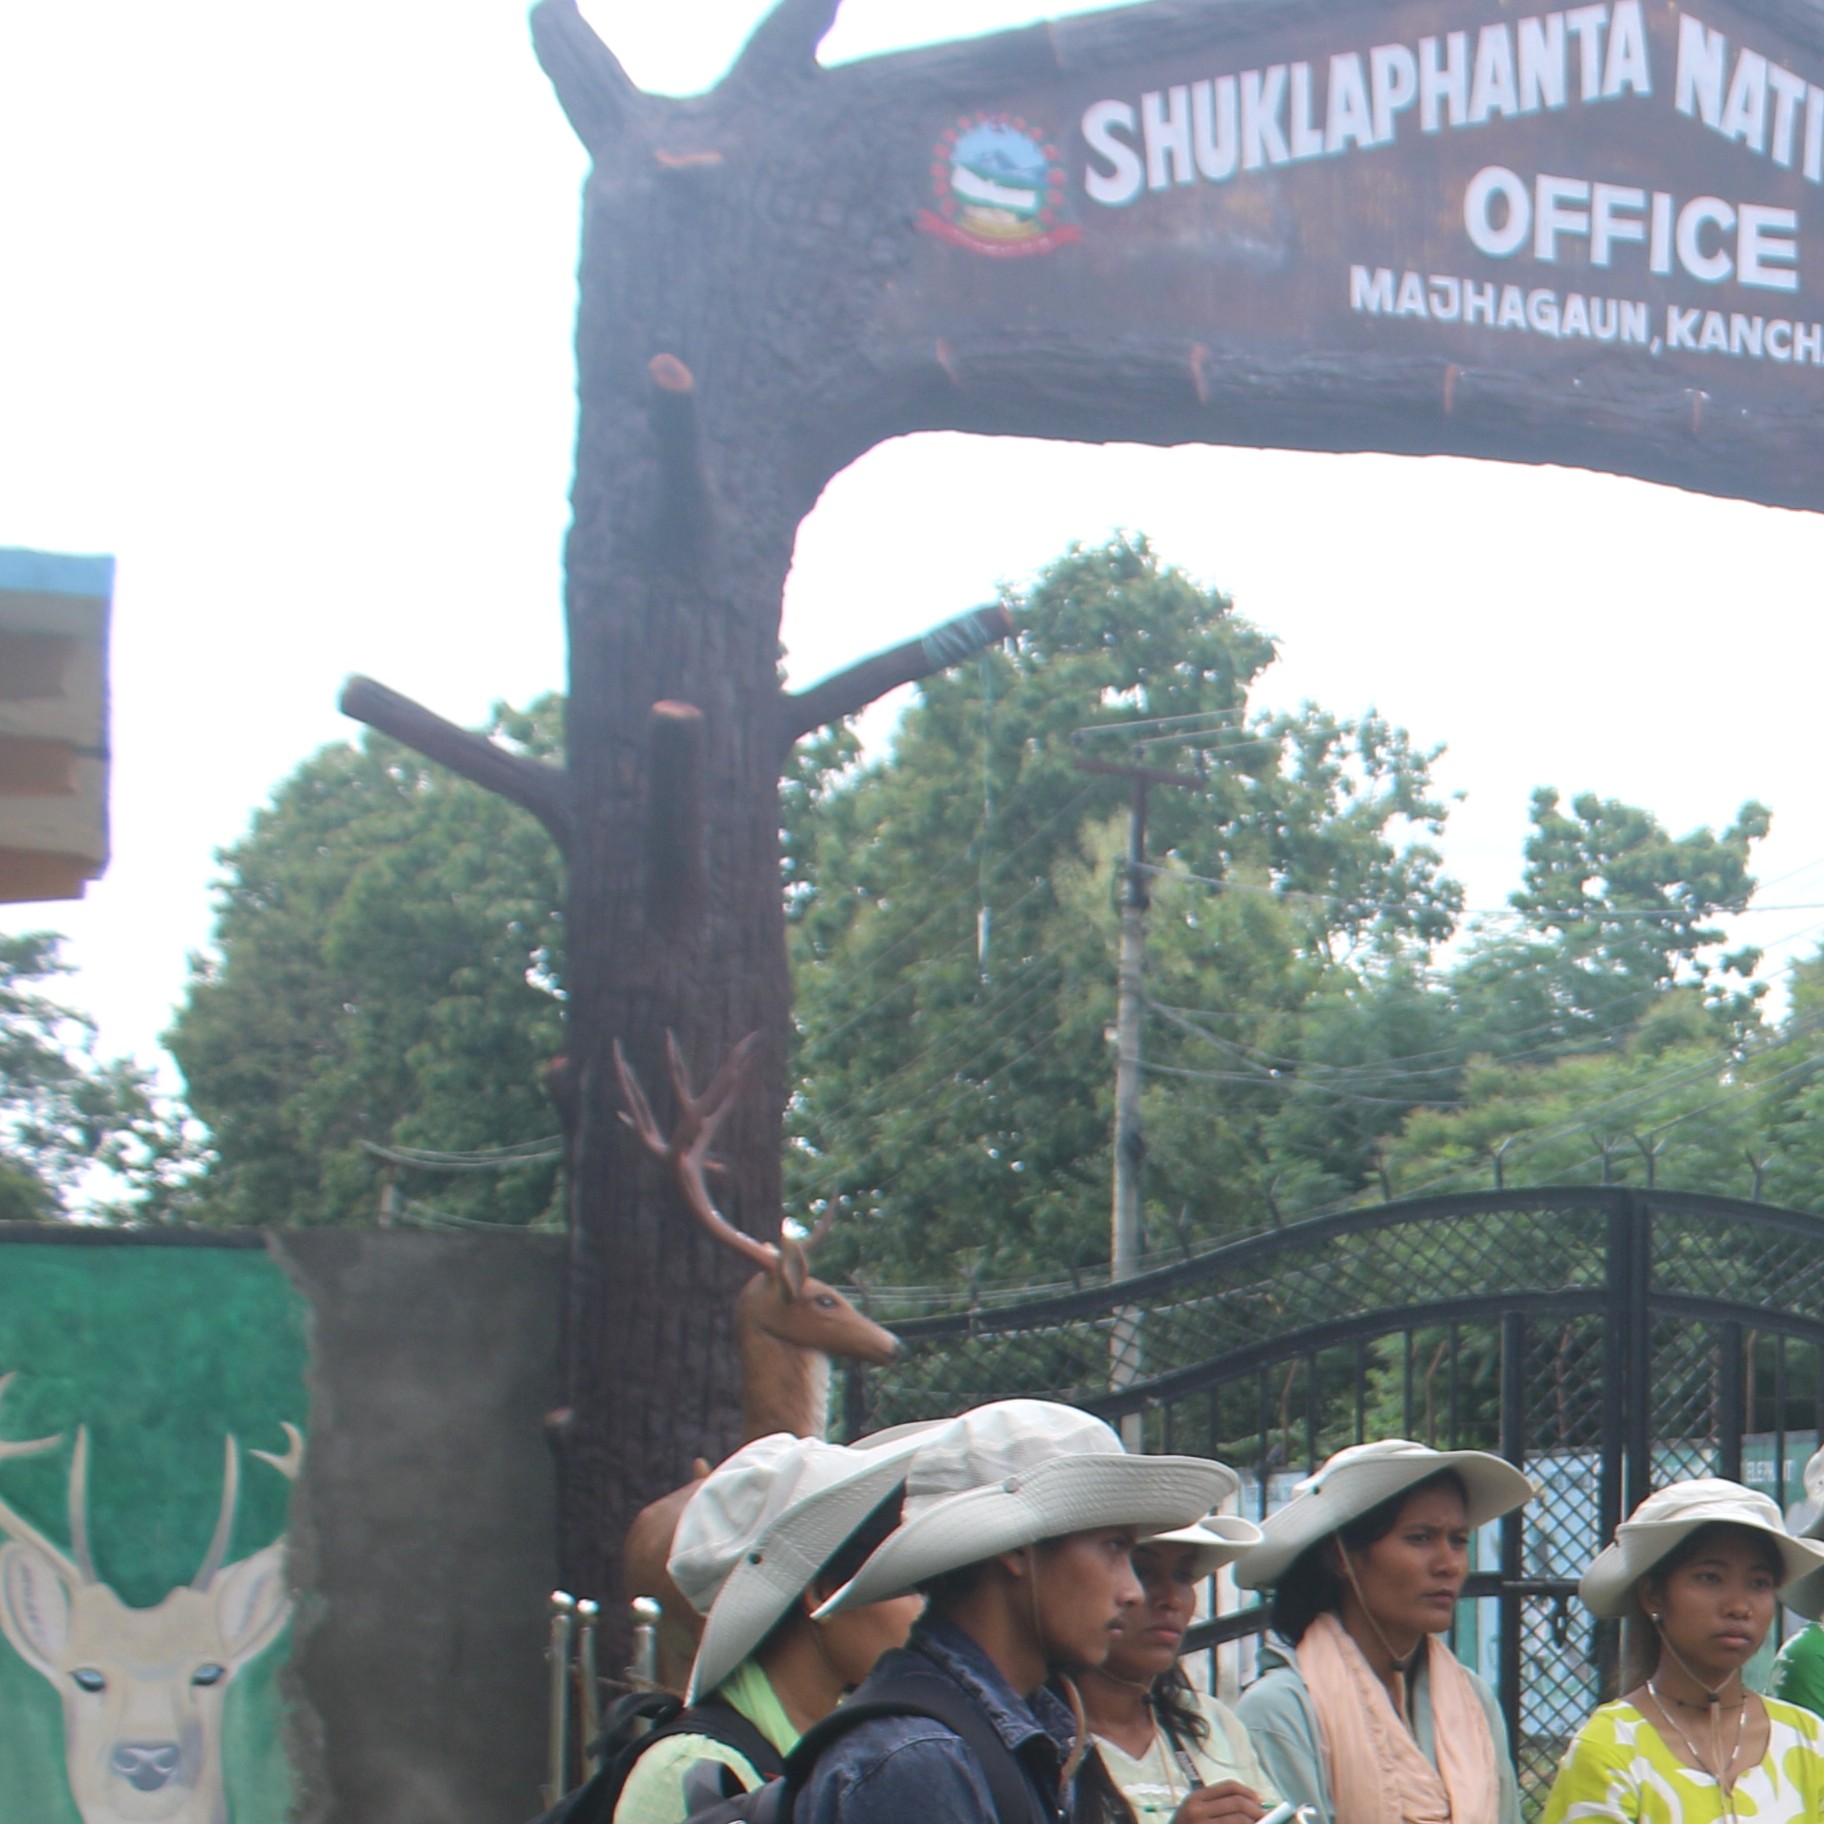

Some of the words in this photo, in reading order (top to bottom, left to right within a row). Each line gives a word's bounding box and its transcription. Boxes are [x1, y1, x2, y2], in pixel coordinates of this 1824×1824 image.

[1081, 0, 1652, 207] SHUKLAPHANTA
[1463, 165, 1798, 291] OFFICE
[1744, 1459, 1793, 1483] ELEPHT
